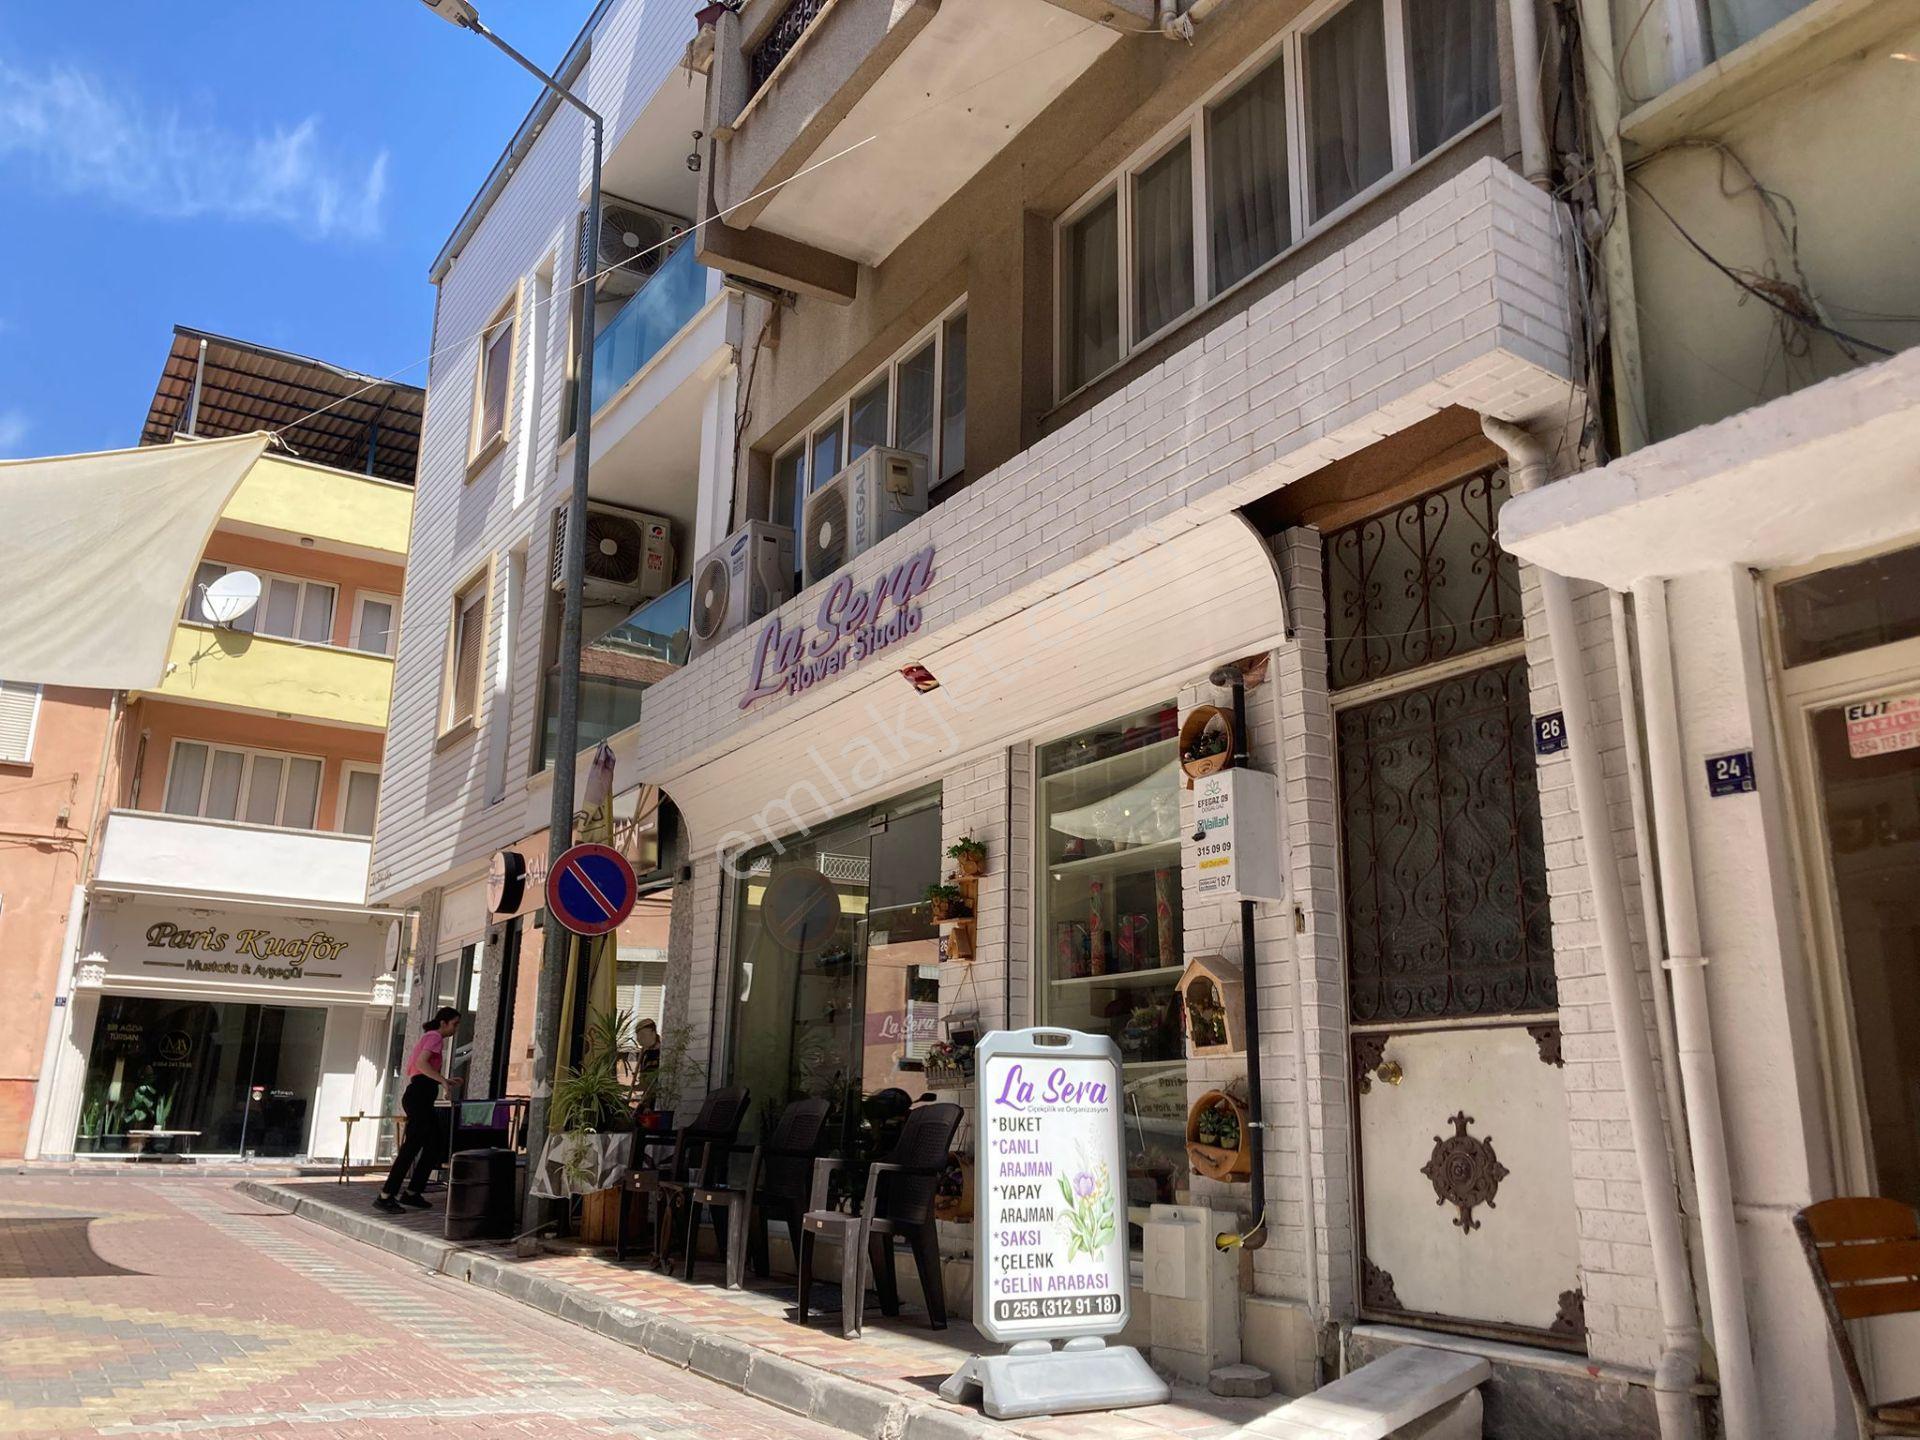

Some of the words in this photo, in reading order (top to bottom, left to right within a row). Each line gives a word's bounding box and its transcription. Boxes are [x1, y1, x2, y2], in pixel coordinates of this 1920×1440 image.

[855, 463, 866, 547] REGAL
[740, 615, 806, 710] La
[807, 545, 937, 658] Sera
[788, 645, 854, 697] Flower
[853, 603, 923, 662] Studio
[1541, 718, 1560, 740] 26
[1716, 758, 1741, 780] 24
[1204, 814, 1229, 830] Vaillant
[1197, 846, 1211, 857] 315
[1211, 843, 1221, 854] 09
[1221, 841, 1232, 852] 09
[1216, 875, 1231, 887] 187
[146, 921, 230, 952] Paris
[235, 928, 349, 967] Kuaför
[186, 958, 239, 974] Mustafa
[240, 966, 252, 975] &
[878, 1014, 899, 1039] La
[900, 1013, 936, 1034] Sera
[995, 1064, 1035, 1112] La
[1042, 1067, 1109, 1104] Sera
[999, 1117, 1042, 1132] BUKET
[1000, 1139, 1039, 1155] CANLI
[1000, 1161, 1053, 1178] ARAJMAN
[1000, 1184, 1042, 1200] YAPAY
[1000, 1206, 1054, 1223] ARAJMAN
[1000, 1229, 1041, 1247] SAKSI
[1001, 1252, 1054, 1275] ÇELENK
[1001, 1272, 1043, 1294] GELİN
[1047, 1273, 1109, 1292] ARABASI
[1001, 1302, 1010, 1319] 0
[1013, 1300, 1038, 1318] 256
[1041, 1299, 1072, 1317] (312
[1075, 1298, 1092, 1315] 91
[1095, 1296, 1117, 1313] 18)
